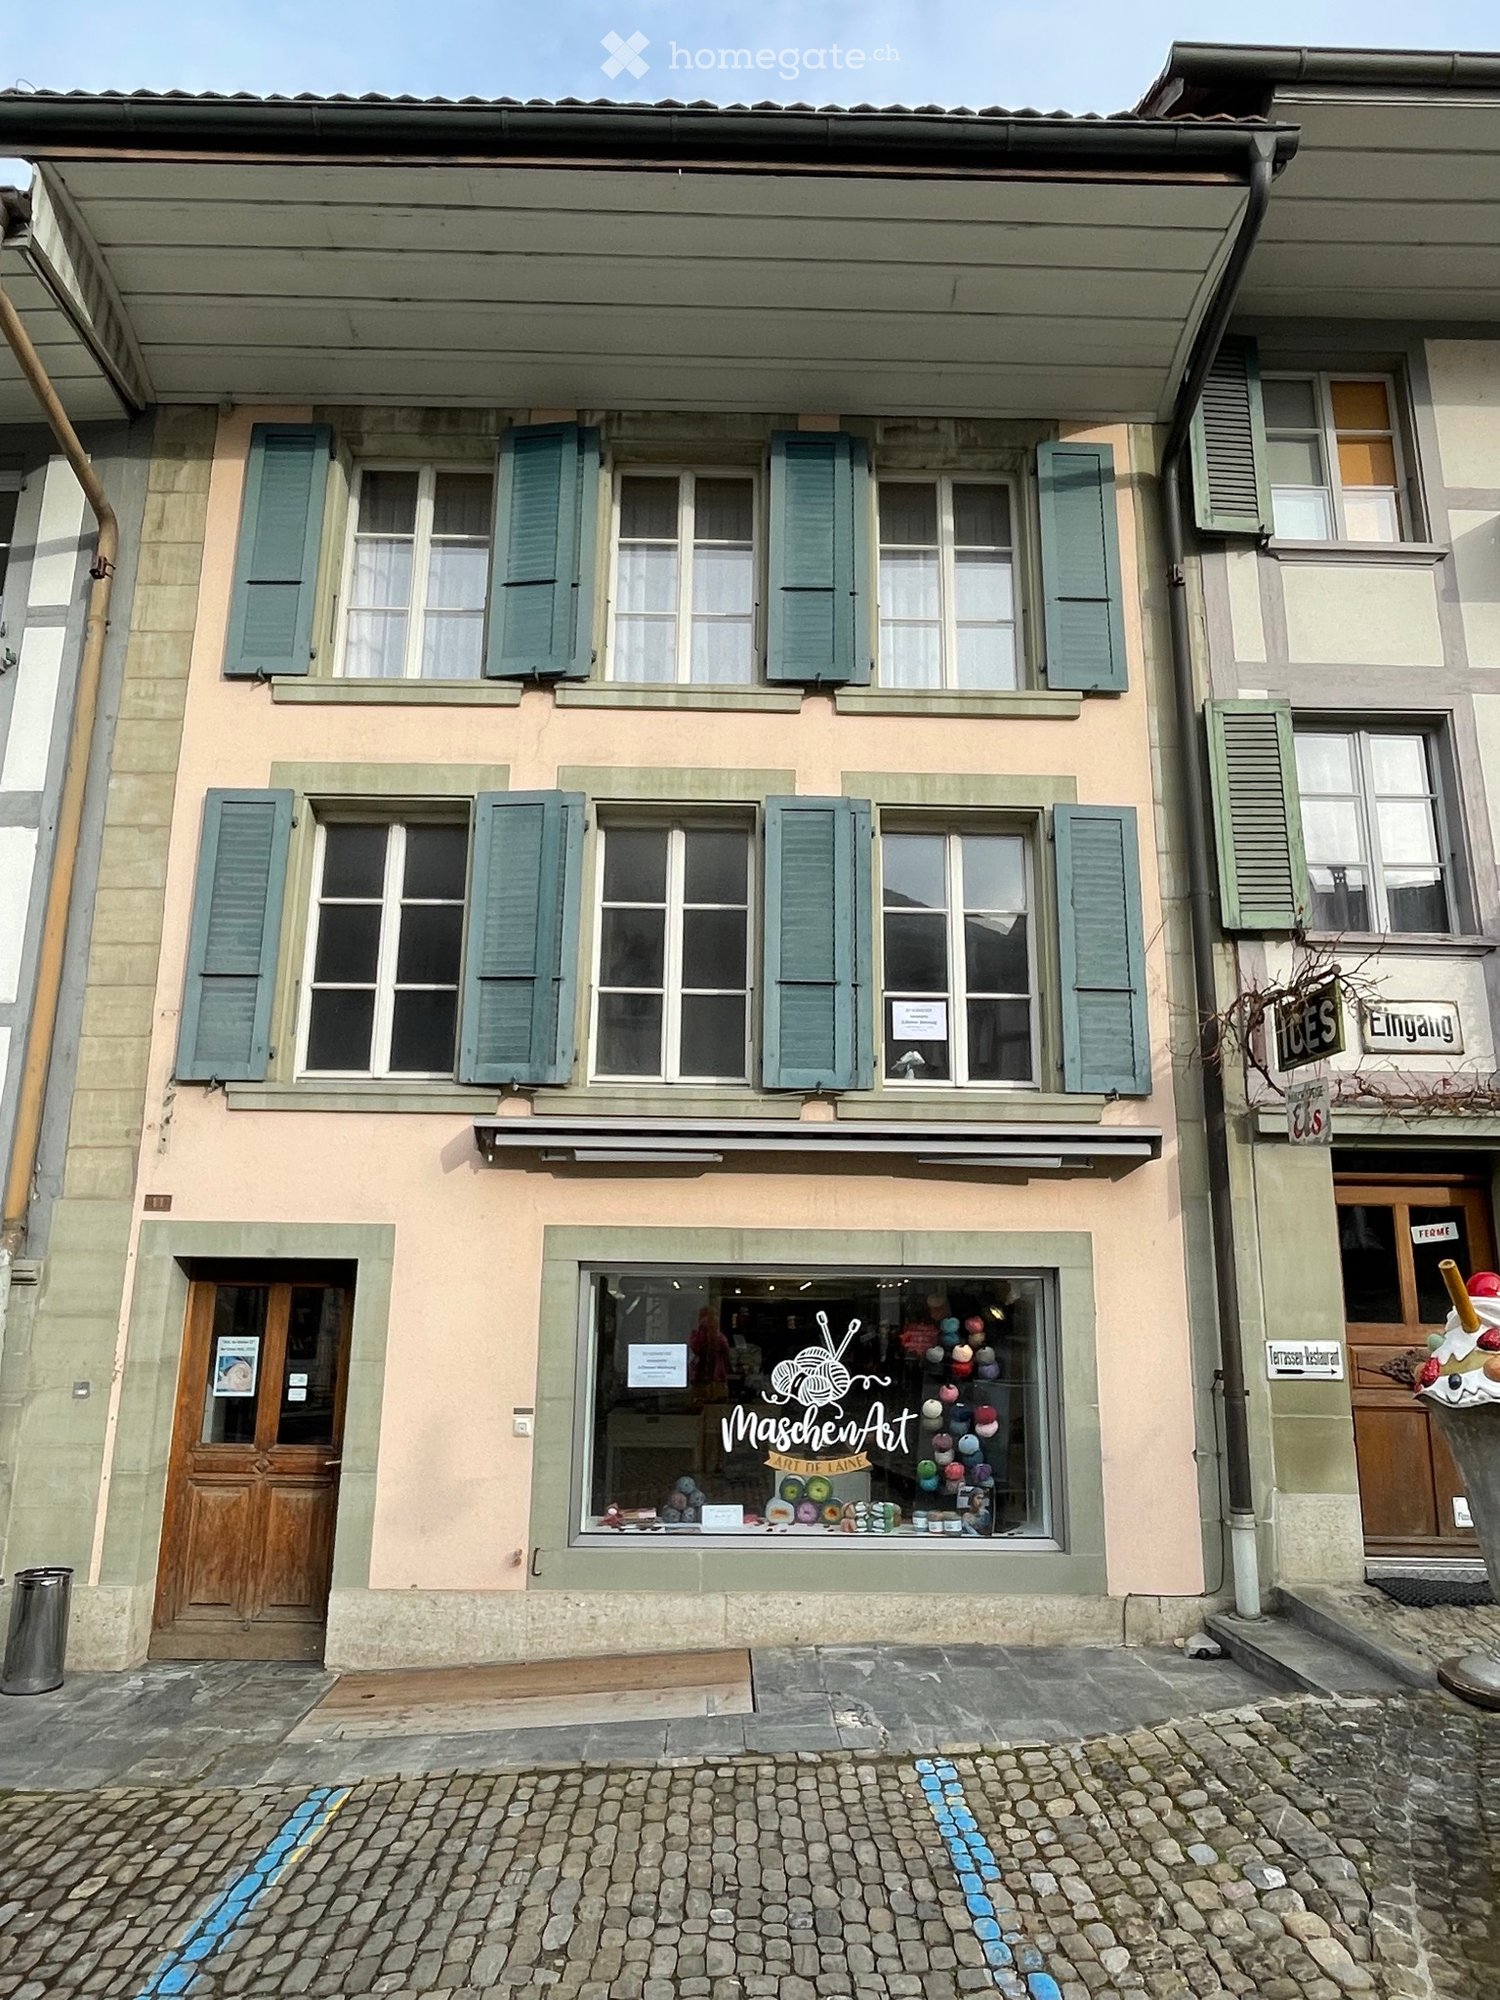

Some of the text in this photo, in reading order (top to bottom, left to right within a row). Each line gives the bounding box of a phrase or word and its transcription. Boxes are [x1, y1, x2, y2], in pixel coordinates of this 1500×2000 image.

[1280, 1000, 1337, 1058] ICES
[1370, 1010, 1454, 1043] Eingang
[1268, 1345, 1340, 1366] Terrassen-Restaurant
[721, 1401, 919, 1454] MaschenArt
[774, 1456, 864, 1473] ART DE LAINE
